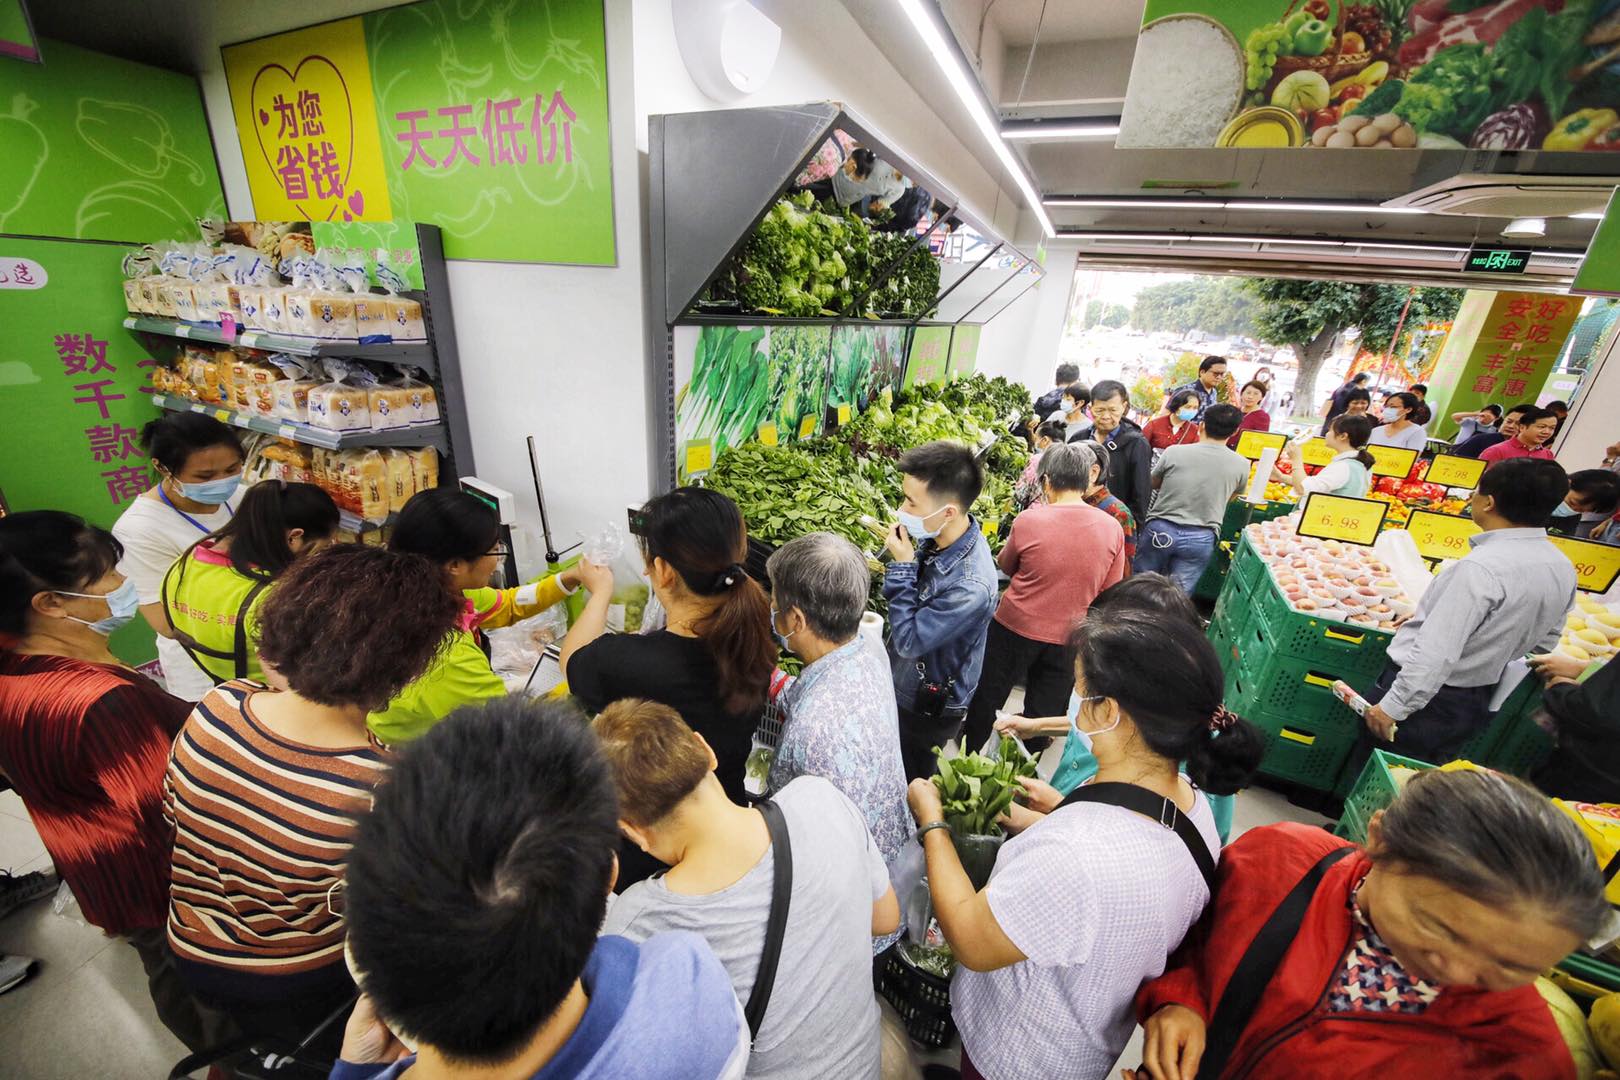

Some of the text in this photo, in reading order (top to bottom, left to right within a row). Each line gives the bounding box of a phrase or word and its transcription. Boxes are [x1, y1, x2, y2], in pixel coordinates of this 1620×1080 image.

[273, 90, 325, 139] 为您
[395, 90, 577, 171] 天天低价
[277, 141, 344, 200] 省钱
[0, 262, 36, 285] 选
[1506, 258, 1523, 266] EXIT
[54, 333, 152, 510] 数千款商
[1321, 514, 1360, 530] 6.98
[1422, 532, 1465, 549] 3.98
